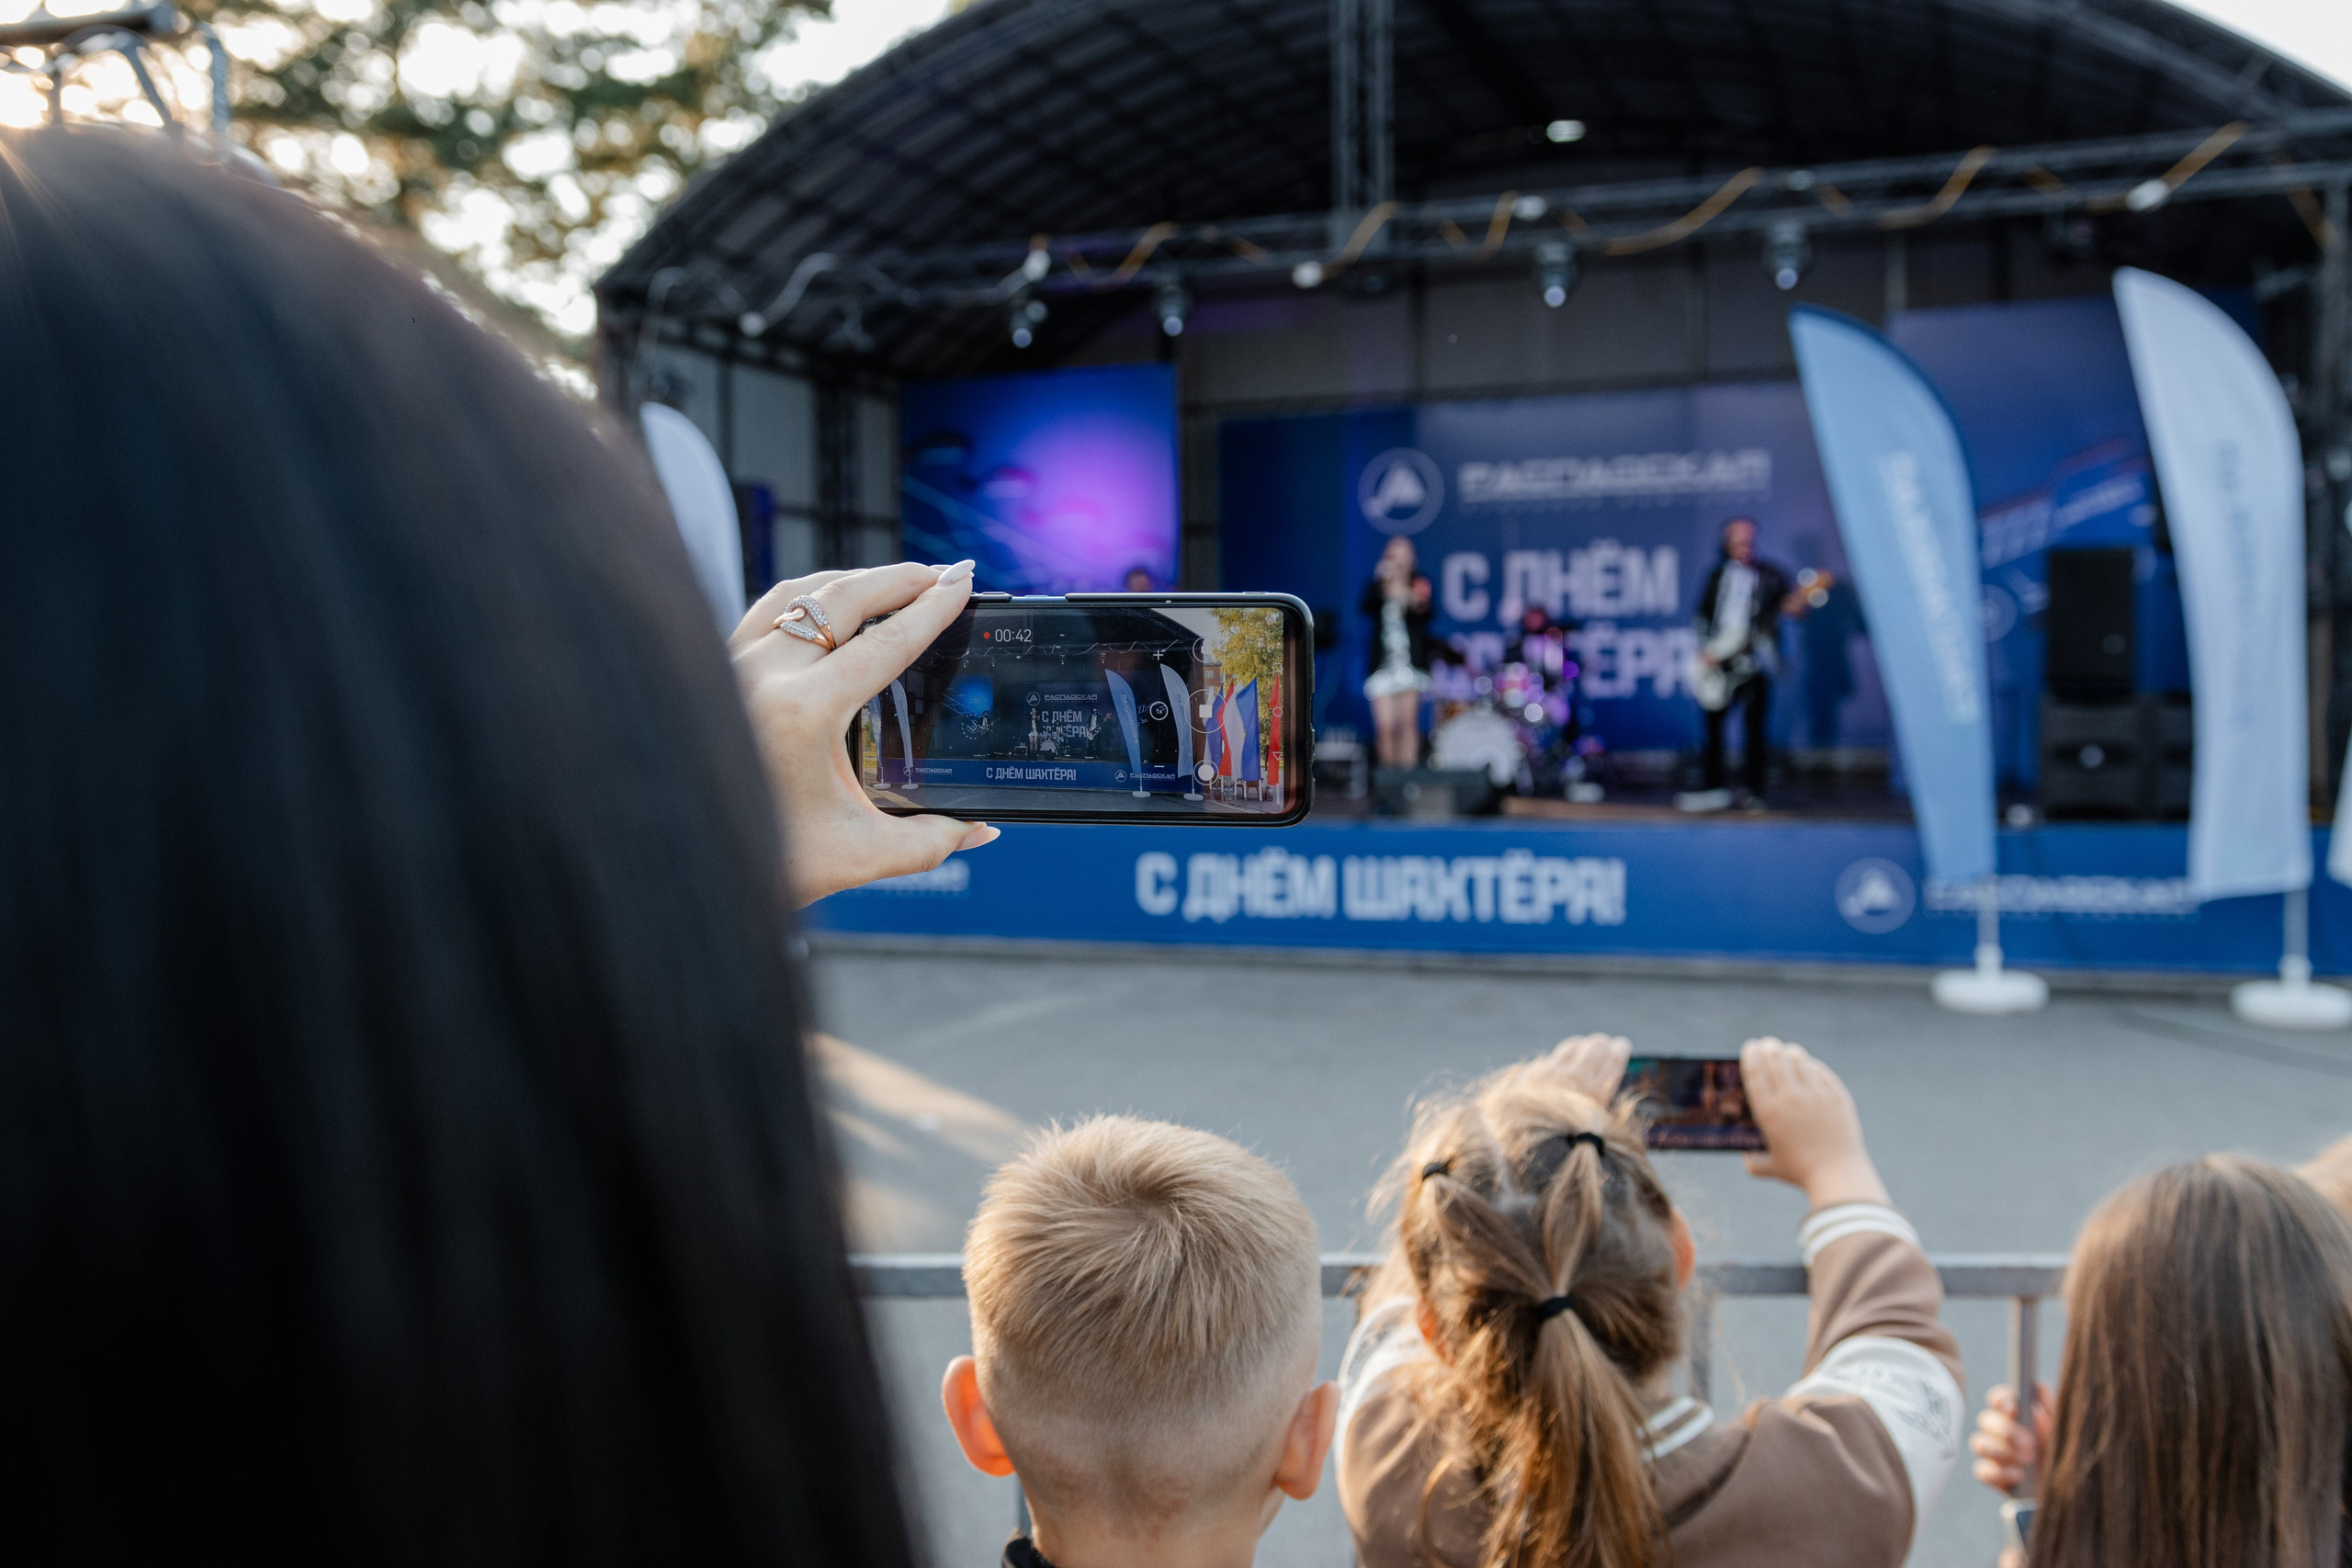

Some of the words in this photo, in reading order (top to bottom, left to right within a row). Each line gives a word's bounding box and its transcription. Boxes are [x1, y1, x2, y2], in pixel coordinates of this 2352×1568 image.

[1442, 552, 1490, 622] С
[994, 628, 1032, 642] 00:42
[1041, 711, 1049, 723] С
[1052, 709, 1082, 724] ДНЁМ
[986, 767, 992, 779] С
[995, 766, 1023, 780] ДНЁМ
[1025, 767, 1077, 781] ШАХТЁРА!
[1135, 851, 1178, 916] С
[1182, 846, 1338, 922] ДНЁМ
[1342, 848, 1627, 926] ШАХТЁРА!
